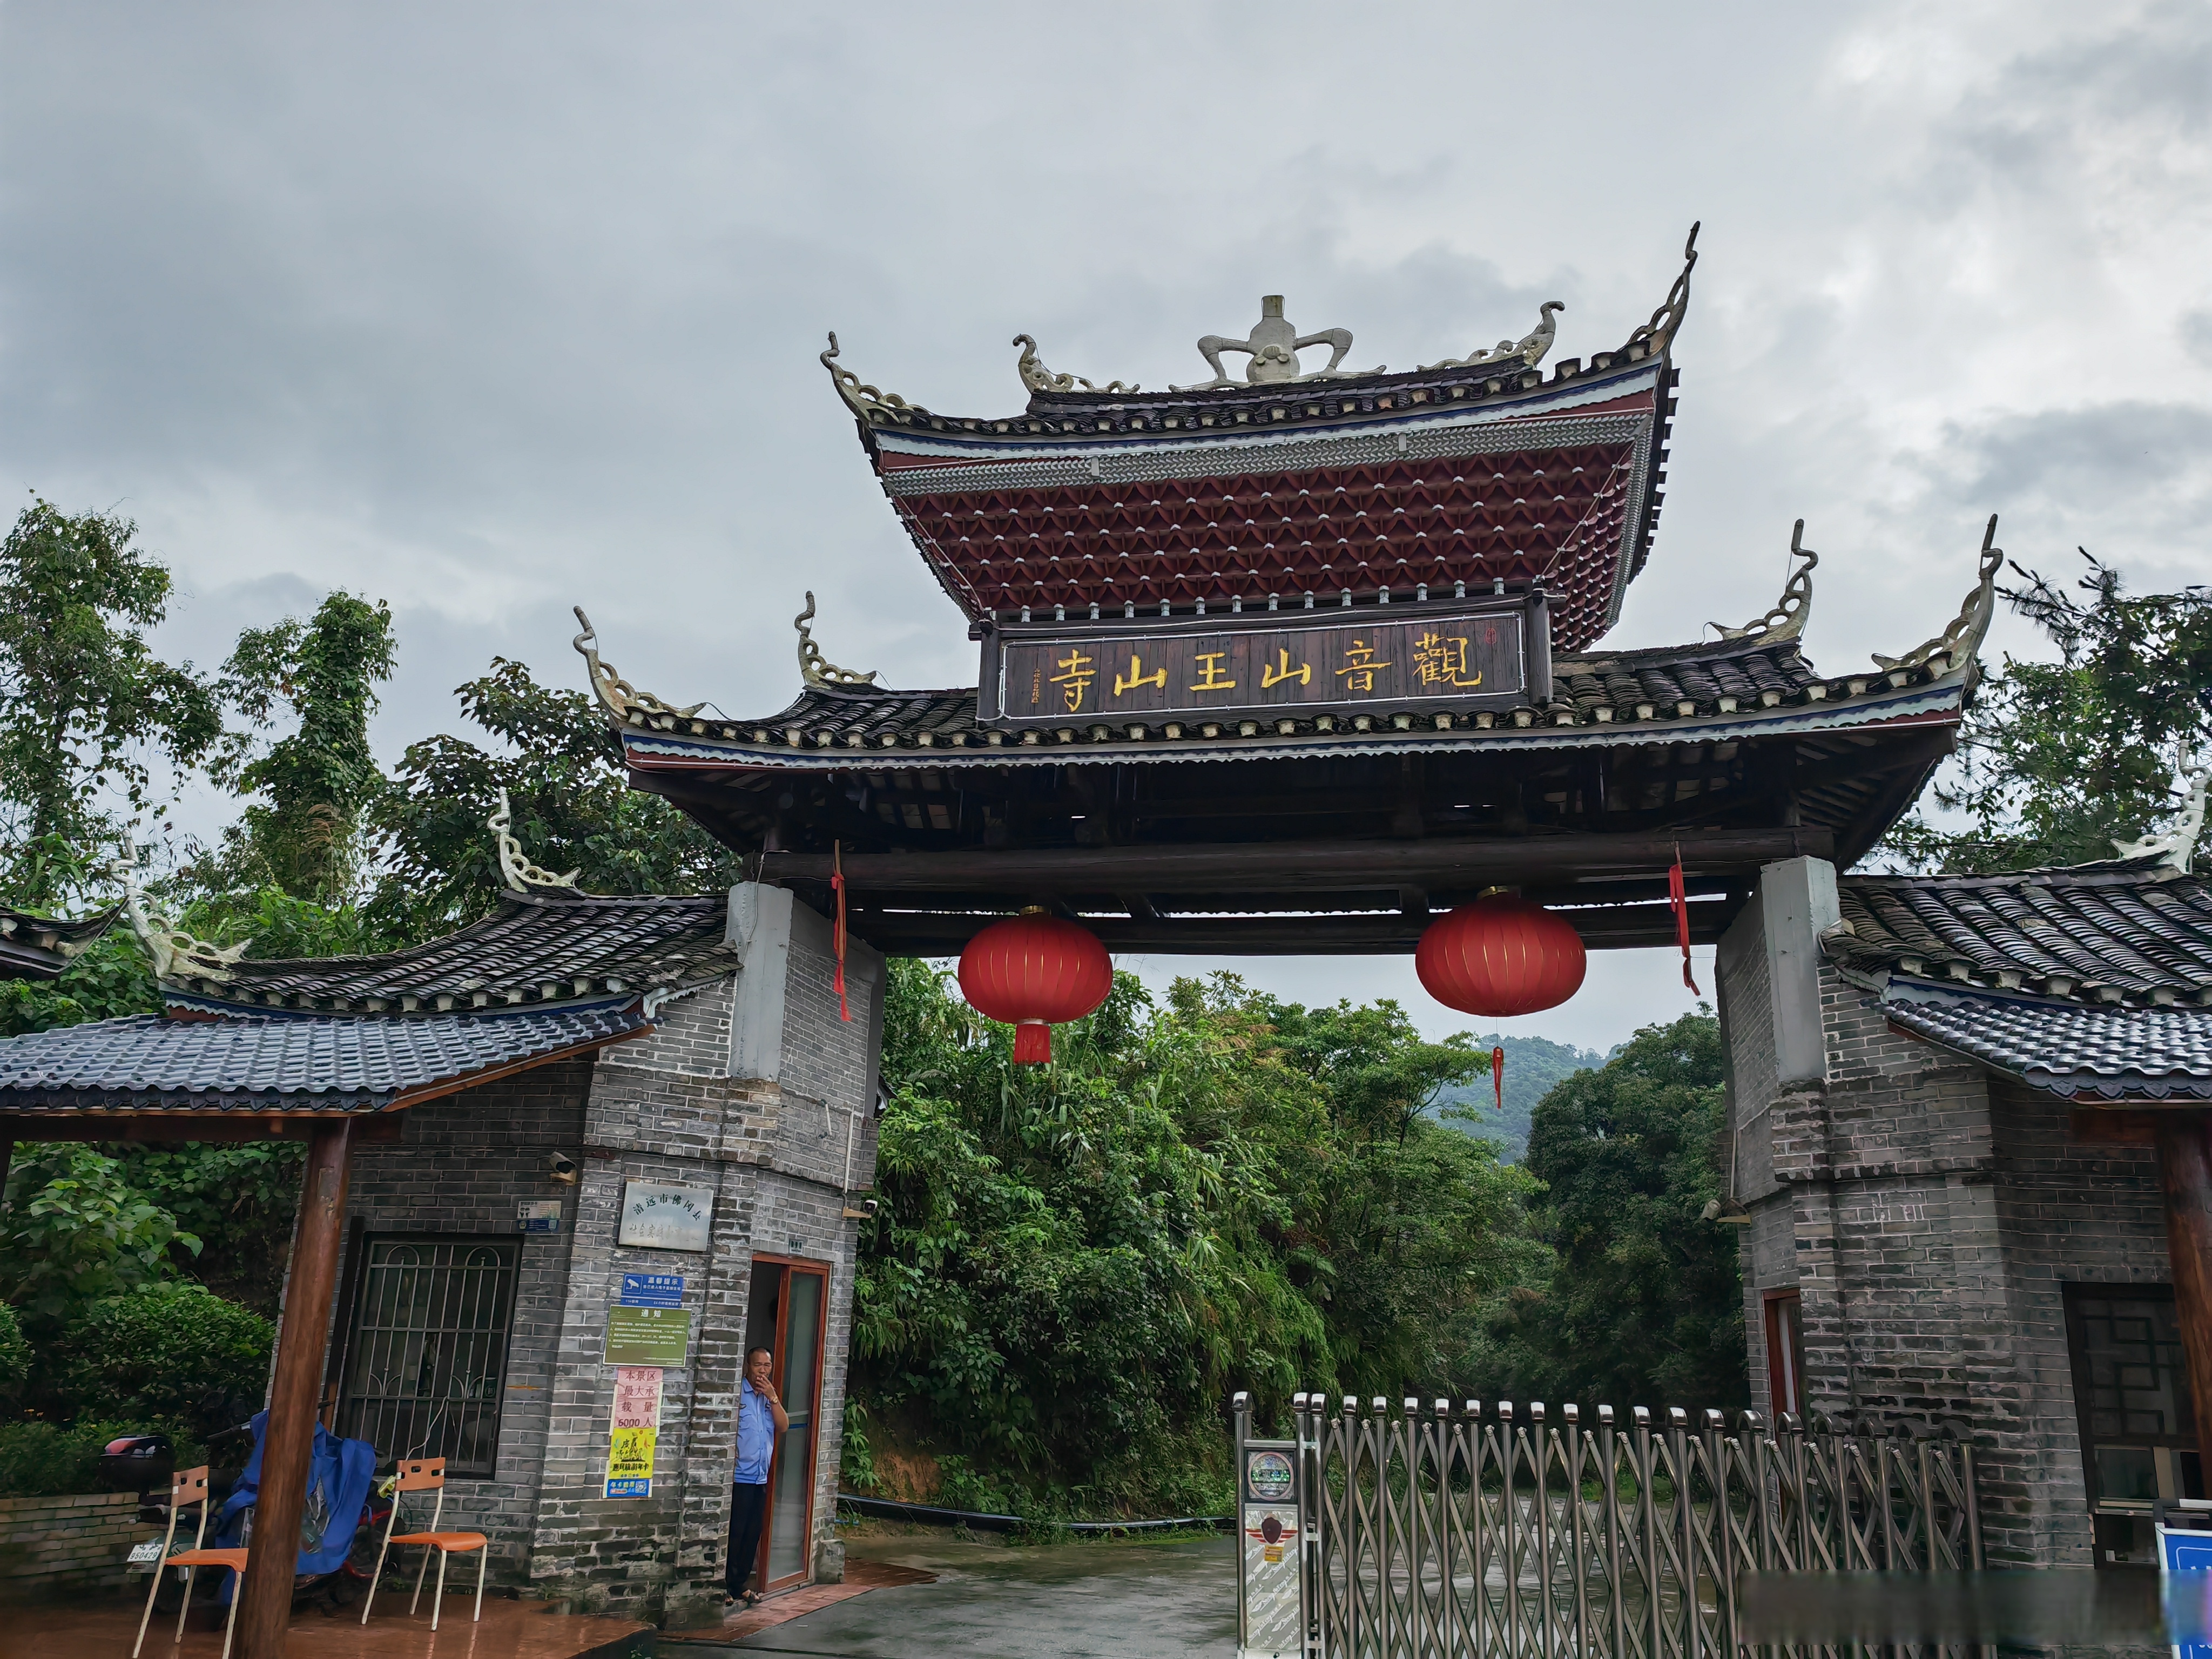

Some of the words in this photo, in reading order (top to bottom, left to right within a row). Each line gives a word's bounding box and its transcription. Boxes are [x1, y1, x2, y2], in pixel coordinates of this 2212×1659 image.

[648, 1276, 679, 1286] 温馨提示
[640, 1309, 662, 1318] 通知
[625, 1370, 656, 1381] 本景区
[623, 1385, 655, 1397] 最大承
[130, 1552, 158, 1560] 950429
